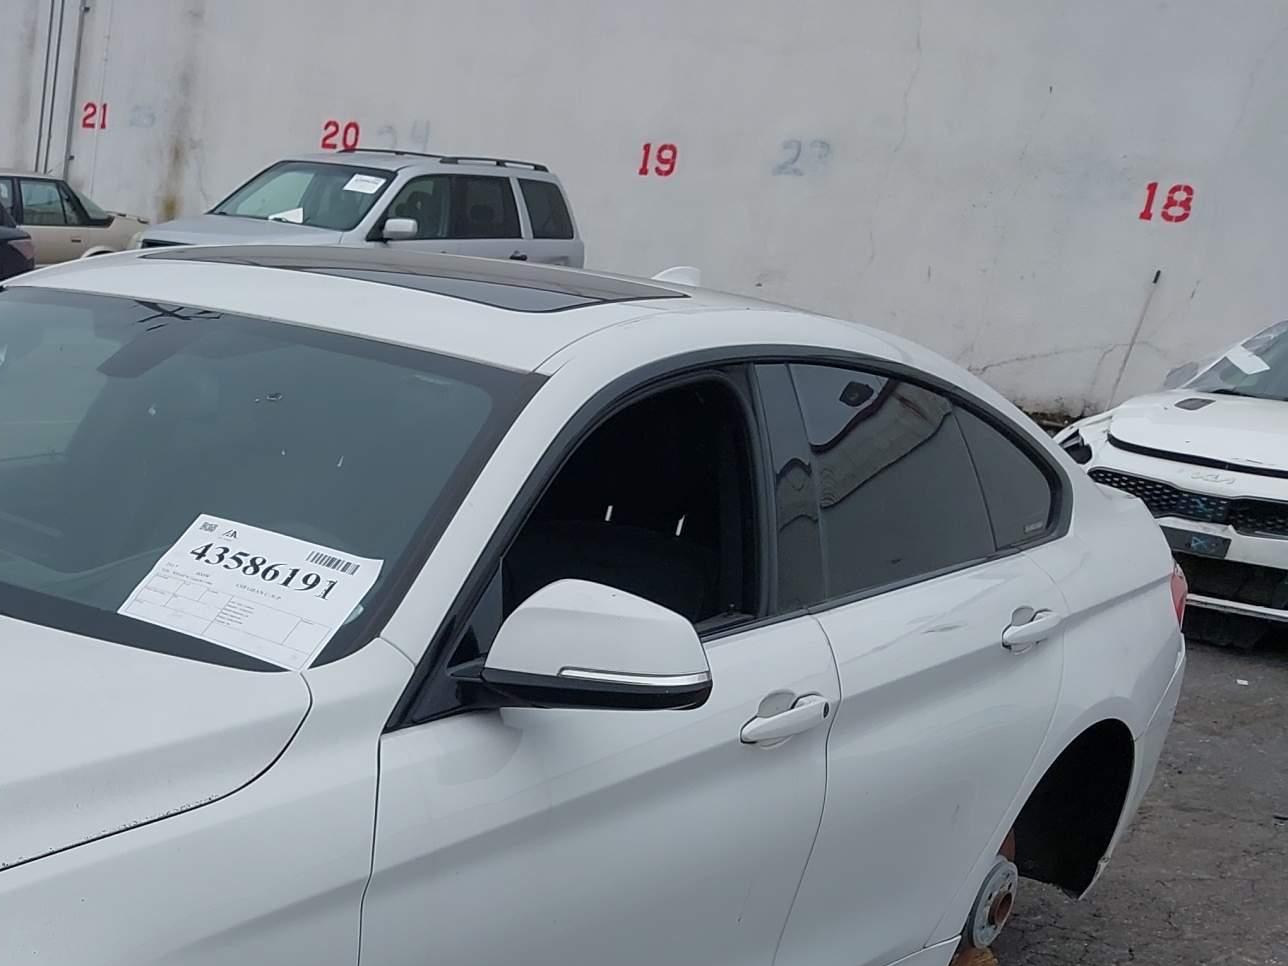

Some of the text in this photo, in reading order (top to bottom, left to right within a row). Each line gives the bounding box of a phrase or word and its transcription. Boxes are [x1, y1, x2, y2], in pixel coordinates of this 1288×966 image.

[82, 102, 107, 129] 21
[320, 120, 360, 152] 20
[638, 143, 678, 177] 19
[1139, 181, 1194, 223] 18
[190, 542, 338, 600] 43586191
